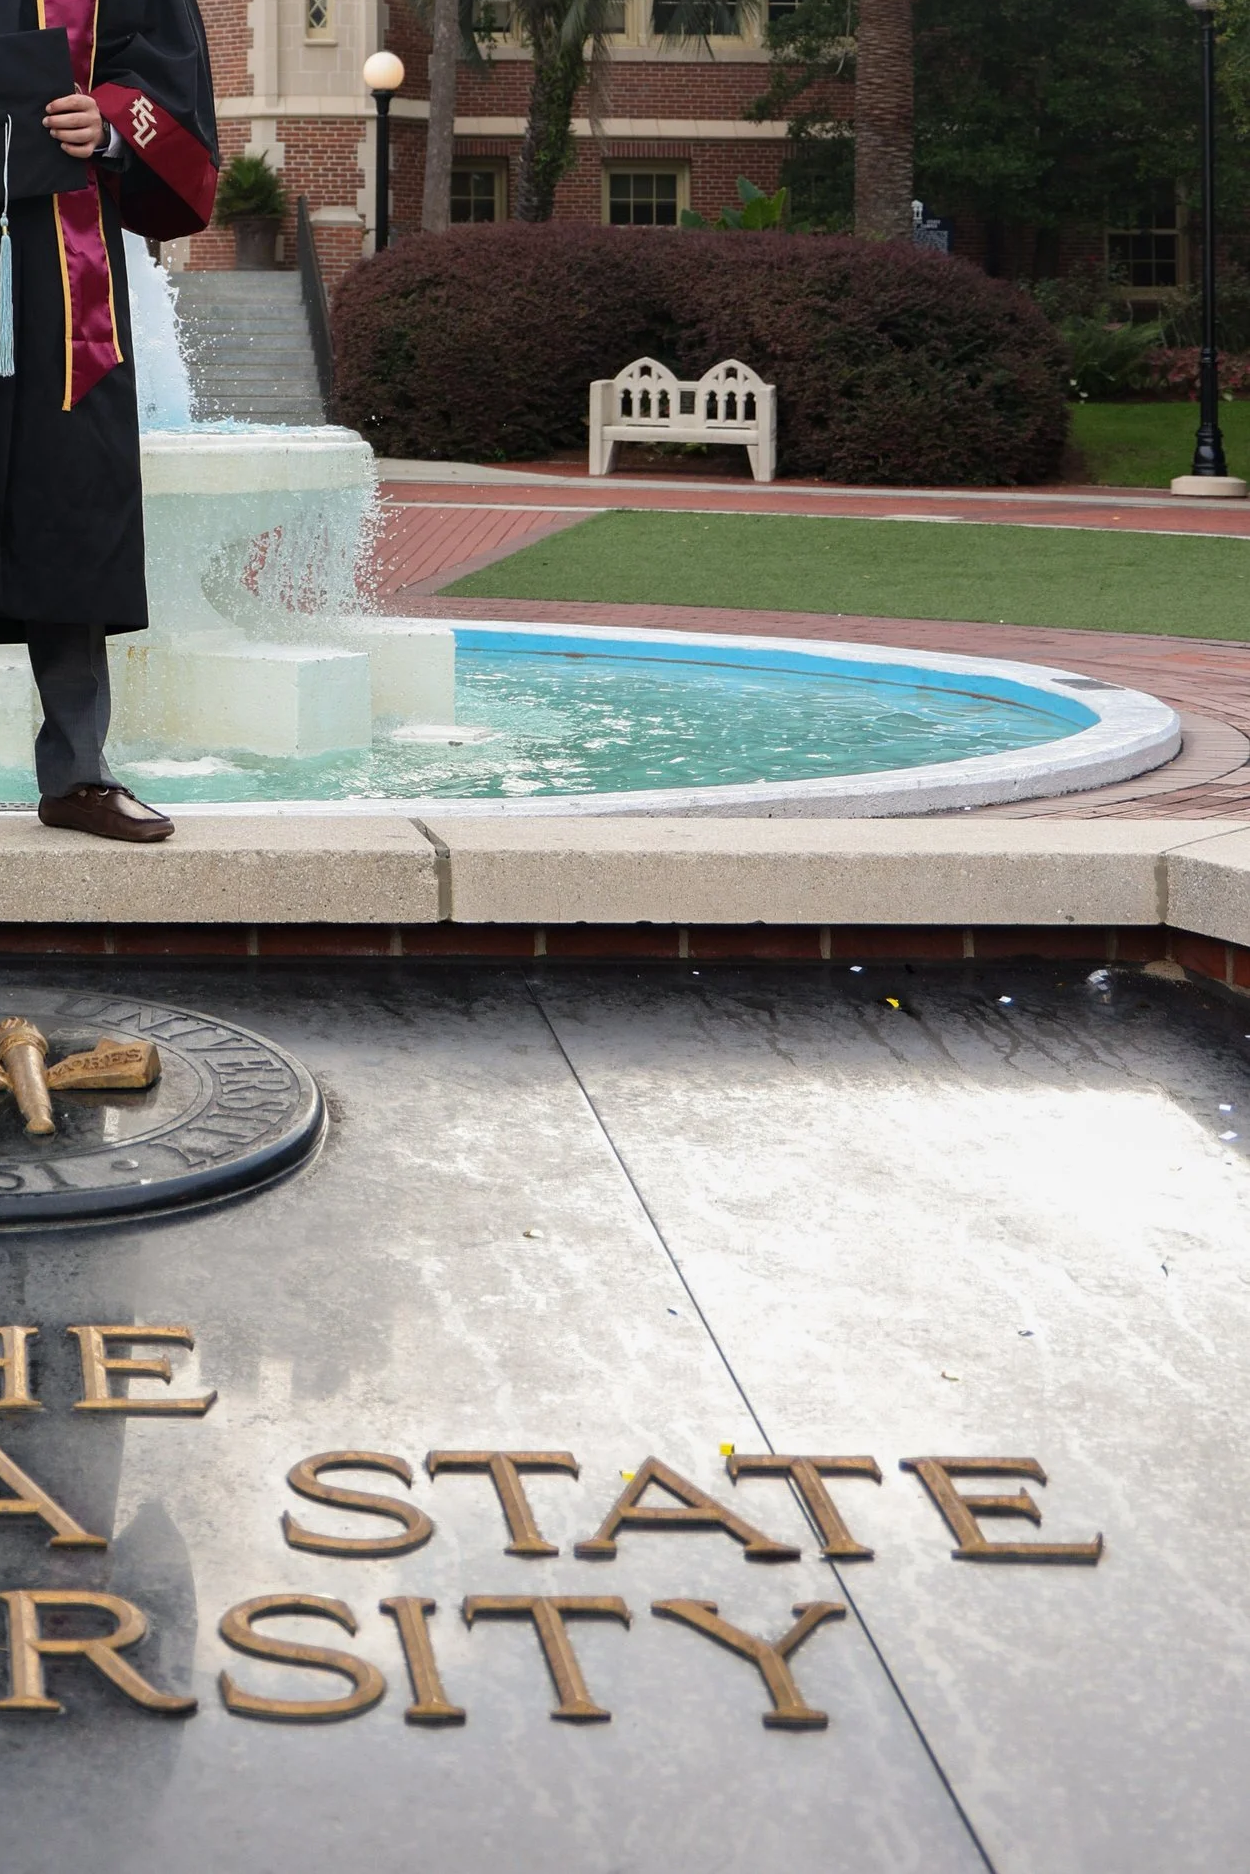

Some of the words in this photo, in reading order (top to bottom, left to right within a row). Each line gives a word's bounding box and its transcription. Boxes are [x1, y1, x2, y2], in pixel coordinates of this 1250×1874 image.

[129, 95, 158, 149] FSU
[54, 994, 292, 1167] UNIVERSITY
[280, 1449, 1106, 1566] STATE
